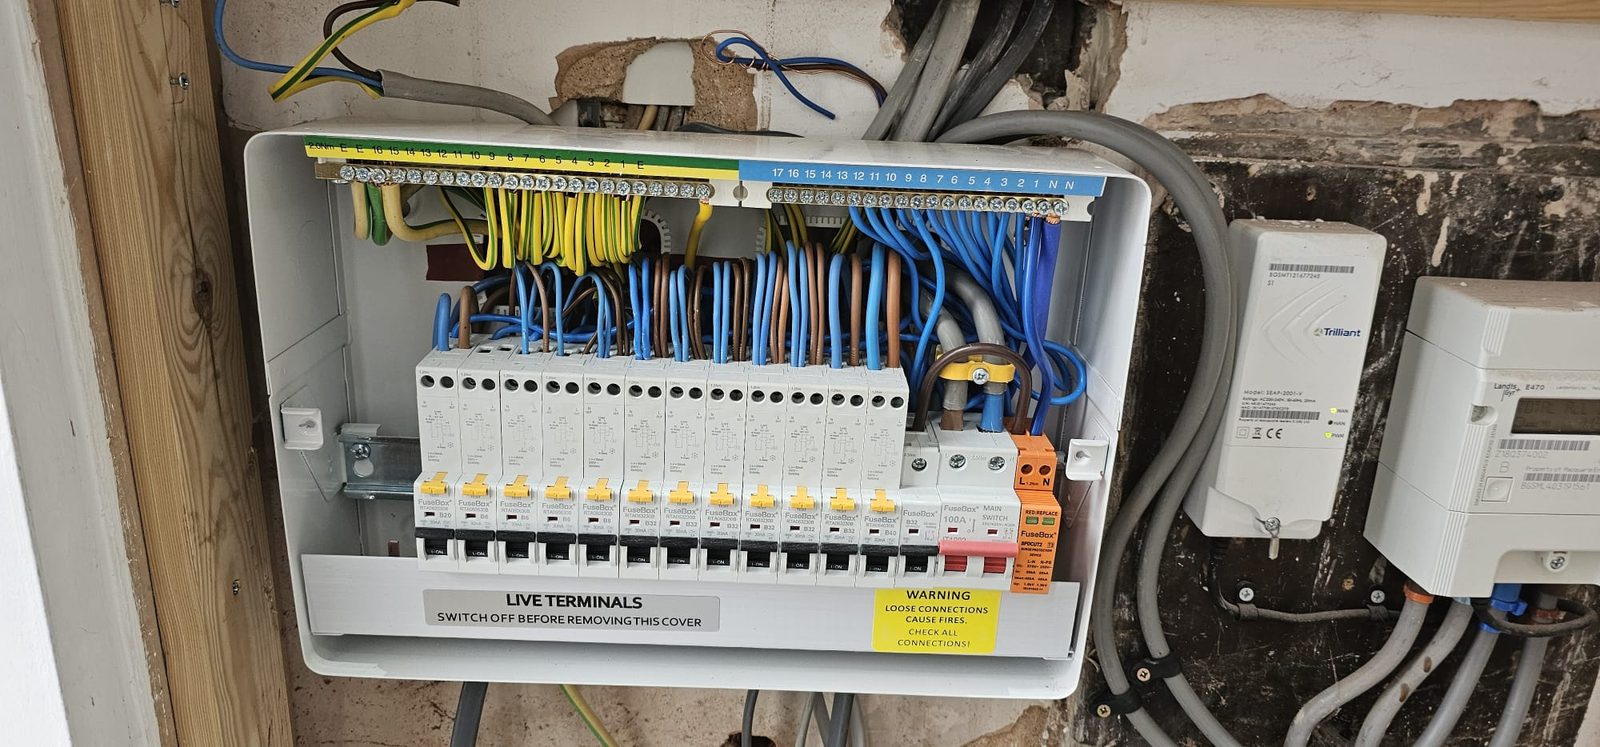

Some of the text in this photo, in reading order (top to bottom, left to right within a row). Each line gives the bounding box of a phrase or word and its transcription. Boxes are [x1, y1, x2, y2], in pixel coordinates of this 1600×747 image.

[340, 144, 348, 152] E
[356, 145, 364, 153] E
[372, 146, 383, 154] 16
[389, 146, 400, 155] 15
[405, 147, 415, 156] 14
[421, 148, 432, 156] 13
[437, 149, 448, 158] 12
[454, 150, 462, 158] 11
[470, 151, 480, 160] 10
[489, 152, 495, 160] 9
[507, 152, 514, 162] 8
[523, 154, 530, 162] 7
[539, 155, 546, 164] 6
[556, 156, 562, 164] 5
[572, 156, 578, 166] 4
[588, 158, 594, 166] 3
[604, 159, 610, 168] 2
[620, 160, 625, 168] 1
[637, 160, 644, 170] E
[772, 168, 1074, 190] 17 16 15 14 13 12 11 10 9 8 7 6 5 4 3 2 1 N N
[1324, 328, 1361, 337] Trilliant
[1019, 477, 1026, 485] L
[1042, 478, 1050, 486] N
[906, 590, 971, 600] WARNING
[506, 594, 643, 609] LIVE TERMINALS
[885, 604, 988, 614] LOOSE CONNECTIONS
[437, 612, 702, 628] SWITCH OFF BEFORE REMOVING THIS COVER
[906, 616, 968, 624] CAUSE FIRES.
[897, 640, 970, 648] CONNECTIONS!
